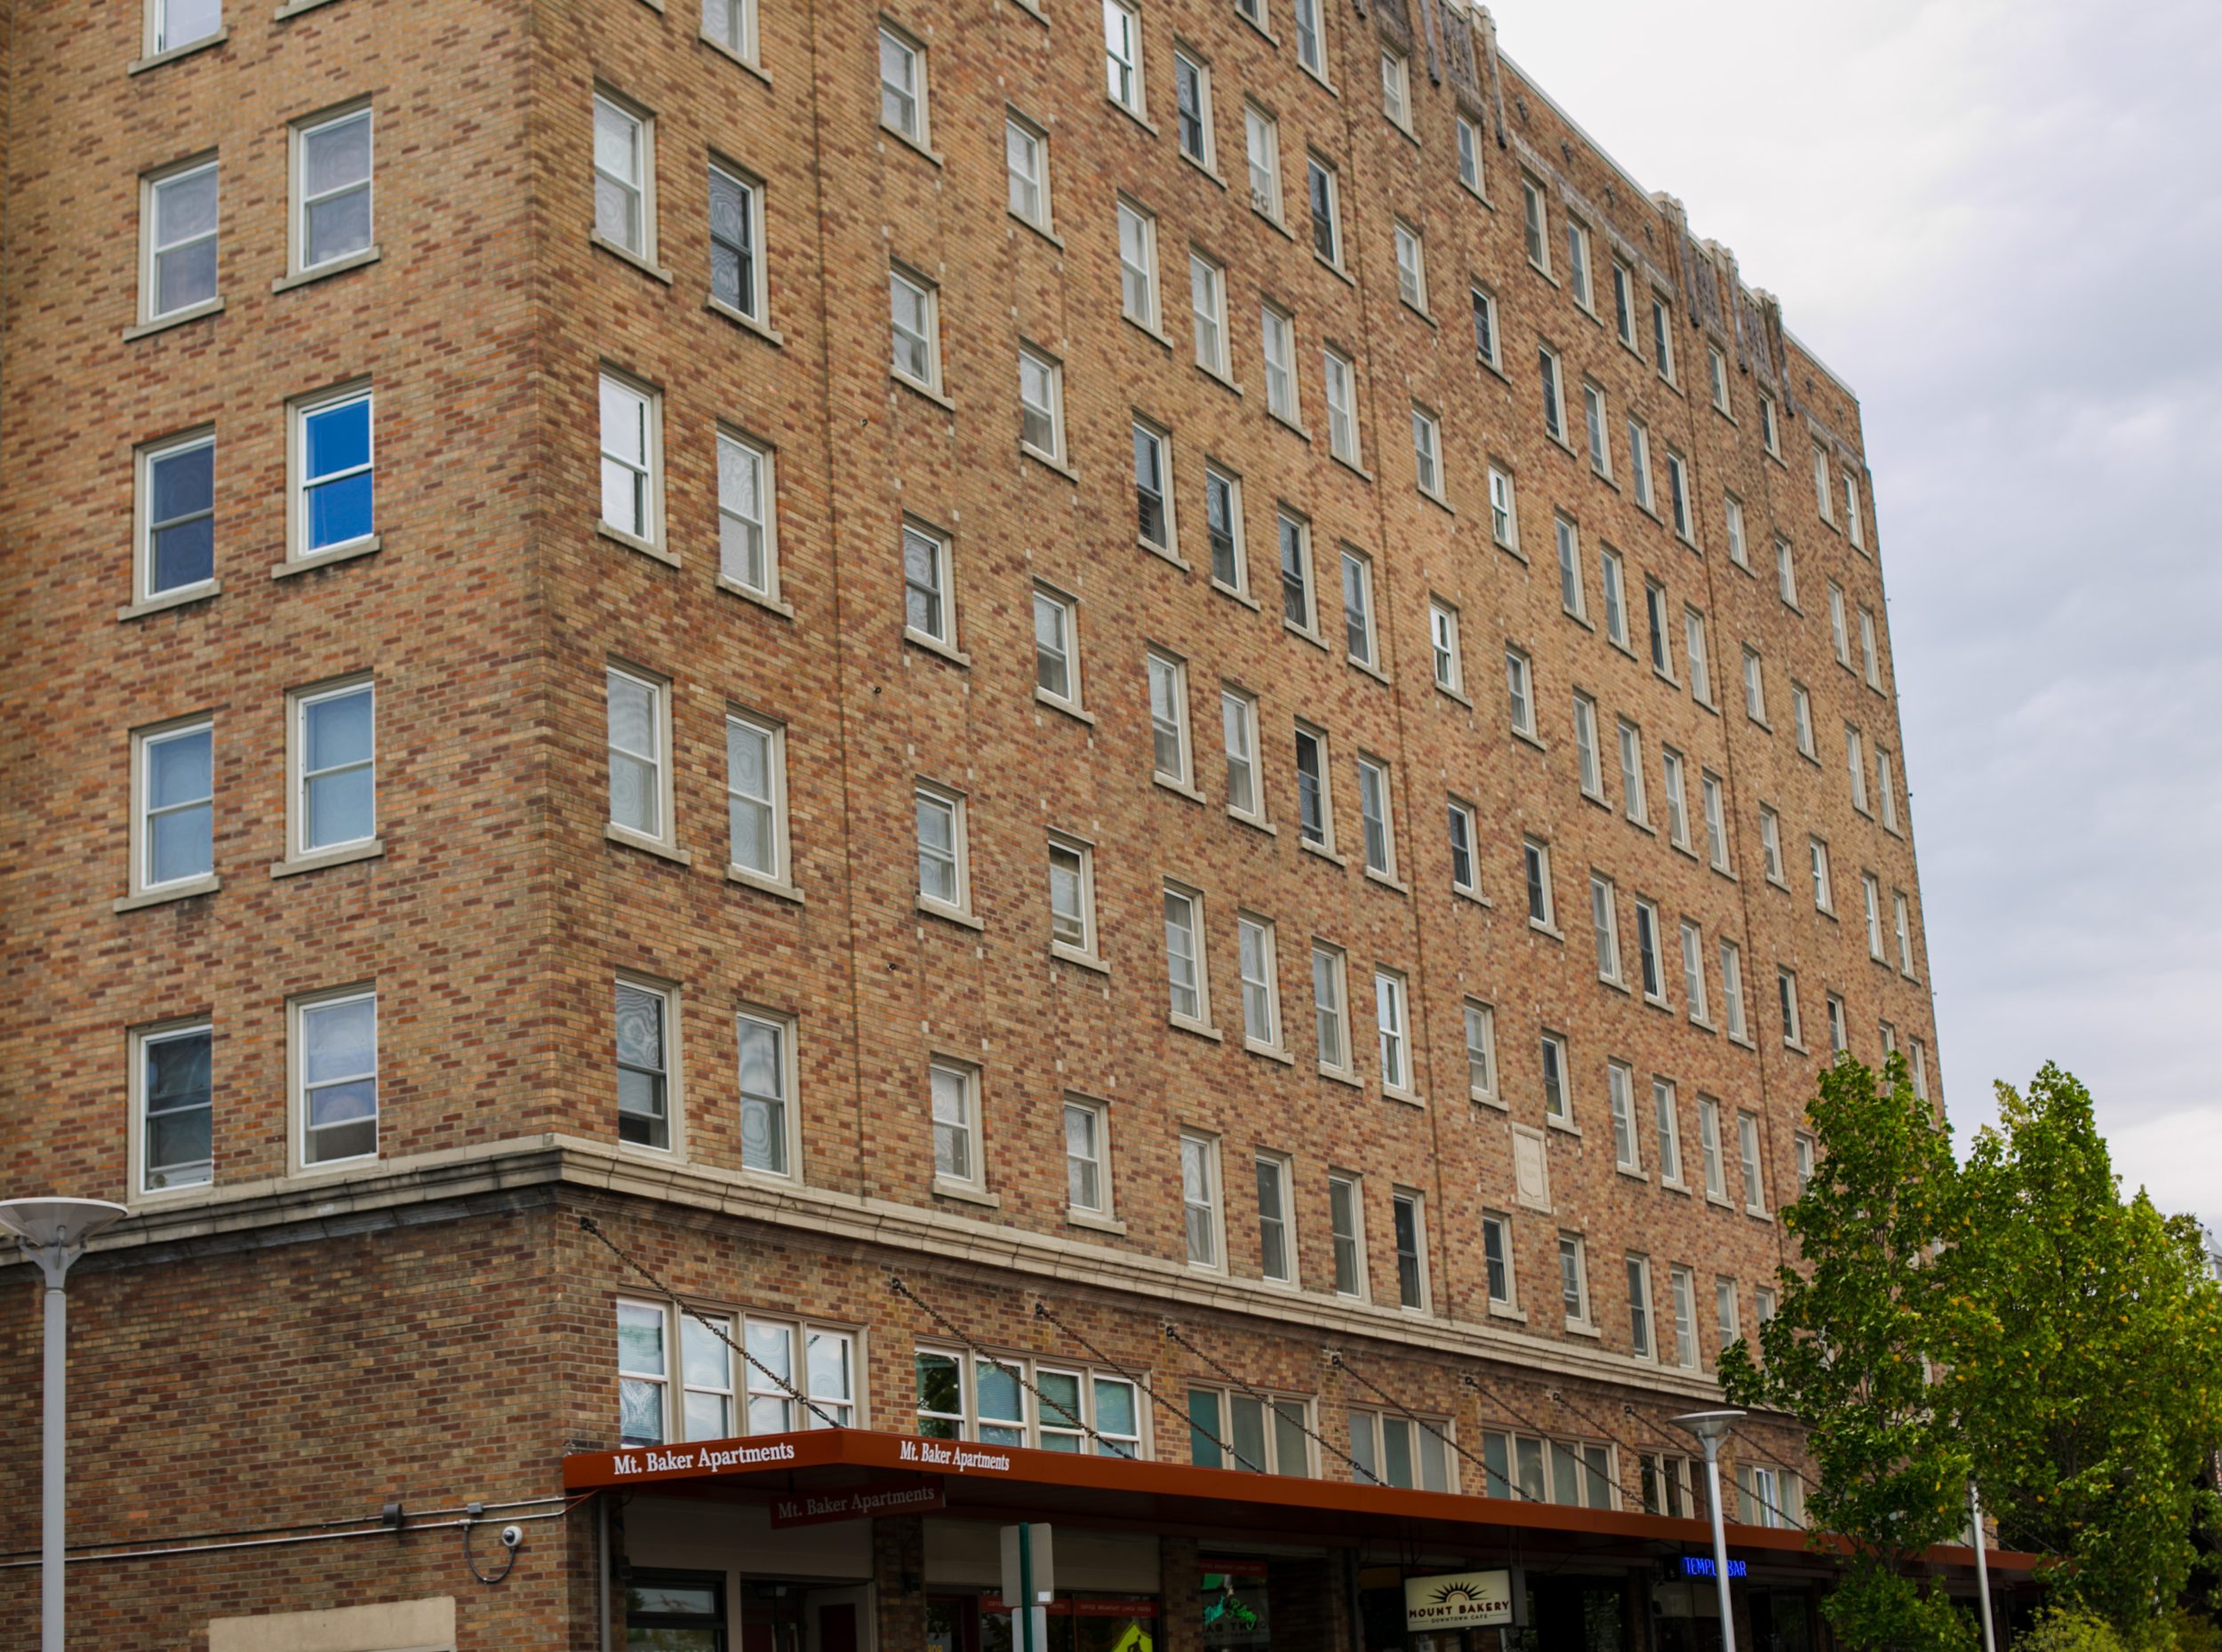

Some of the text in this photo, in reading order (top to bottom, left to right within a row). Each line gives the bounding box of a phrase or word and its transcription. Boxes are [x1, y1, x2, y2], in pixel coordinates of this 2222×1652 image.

[613, 1442, 795, 1475] Mt. Baker Apartments
[899, 1441, 1010, 1472] Mt. Baker Apartments
[778, 1486, 935, 1519] Mt. Baker Apartments
[1683, 1556, 1747, 1577] TEMPL BAR
[1409, 1600, 1510, 1619] MOUNT BAKERY
[1430, 1616, 1468, 1624] DOWNTOWN
